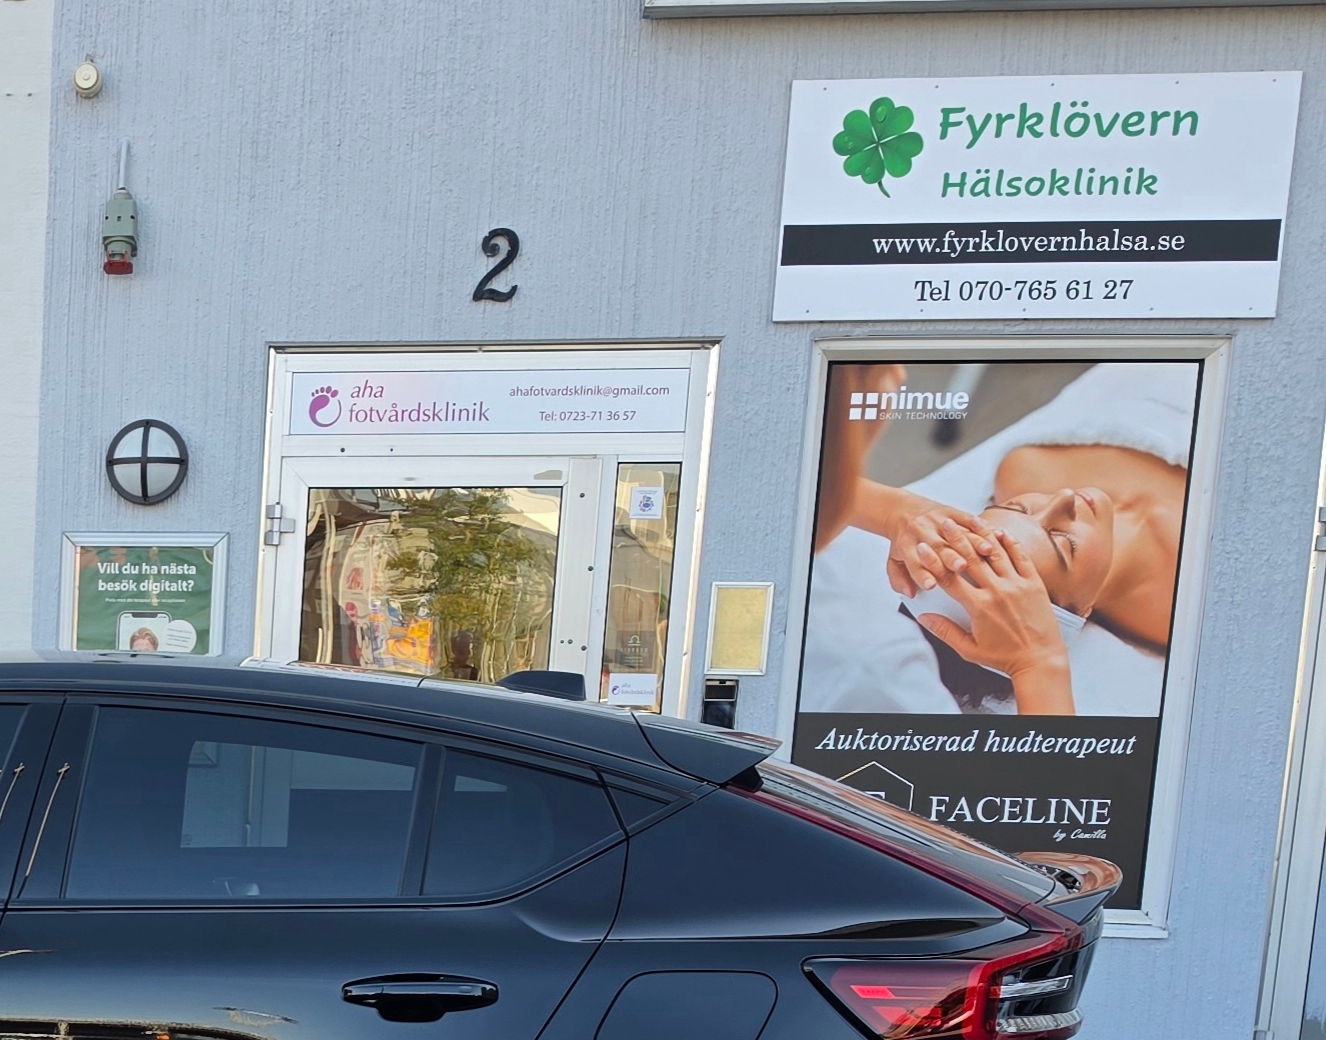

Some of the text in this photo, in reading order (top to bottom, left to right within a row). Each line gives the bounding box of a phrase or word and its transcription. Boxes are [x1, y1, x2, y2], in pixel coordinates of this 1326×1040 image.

[938, 101, 1200, 149] Fyrklövern
[941, 166, 1159, 198] Hälsoklinik
[872, 229, 1186, 258] www.fyrklovernhalsa.se
[472, 227, 520, 303] 2
[914, 279, 1134, 301] Tel 070-765 61 27
[350, 380, 385, 399] aha
[509, 384, 670, 398] ahafotvardsklinik@gmail.com
[880, 386, 970, 410] nimue
[348, 401, 490, 424] fotvårdsklinik
[539, 410, 637, 422] Tel: 0723-71 36 57
[879, 412, 968, 420] SKIN TECHNOLOGY
[97, 563, 197, 575] Vill du ha nästa
[98, 580, 195, 594] besök digitalt?
[815, 727, 1137, 759] Auktoriserad hudterapeut
[928, 796, 1112, 825] FACELINE
[1052, 829, 1107, 841] by Camilla
